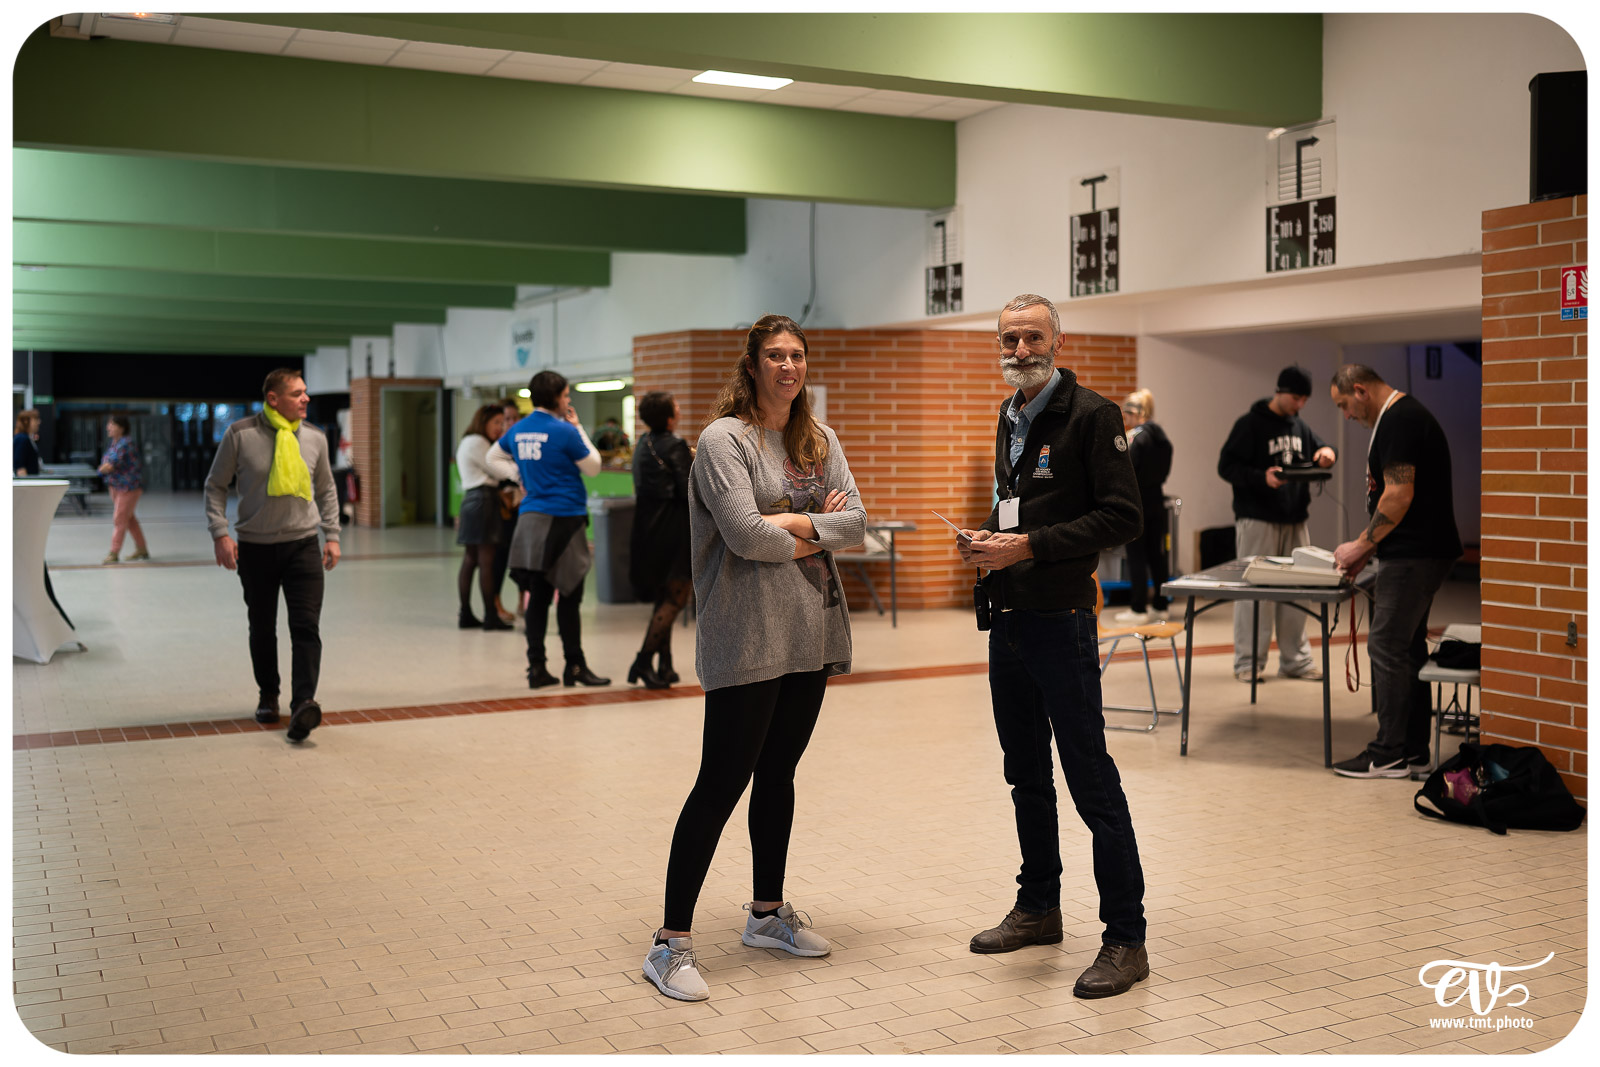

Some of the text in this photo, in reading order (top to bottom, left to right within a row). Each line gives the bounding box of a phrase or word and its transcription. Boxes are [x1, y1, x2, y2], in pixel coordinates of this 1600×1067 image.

[1271, 201, 1334, 239] E101 à E150
[1271, 240, 1290, 272] F41
[1309, 234, 1334, 266] F210
